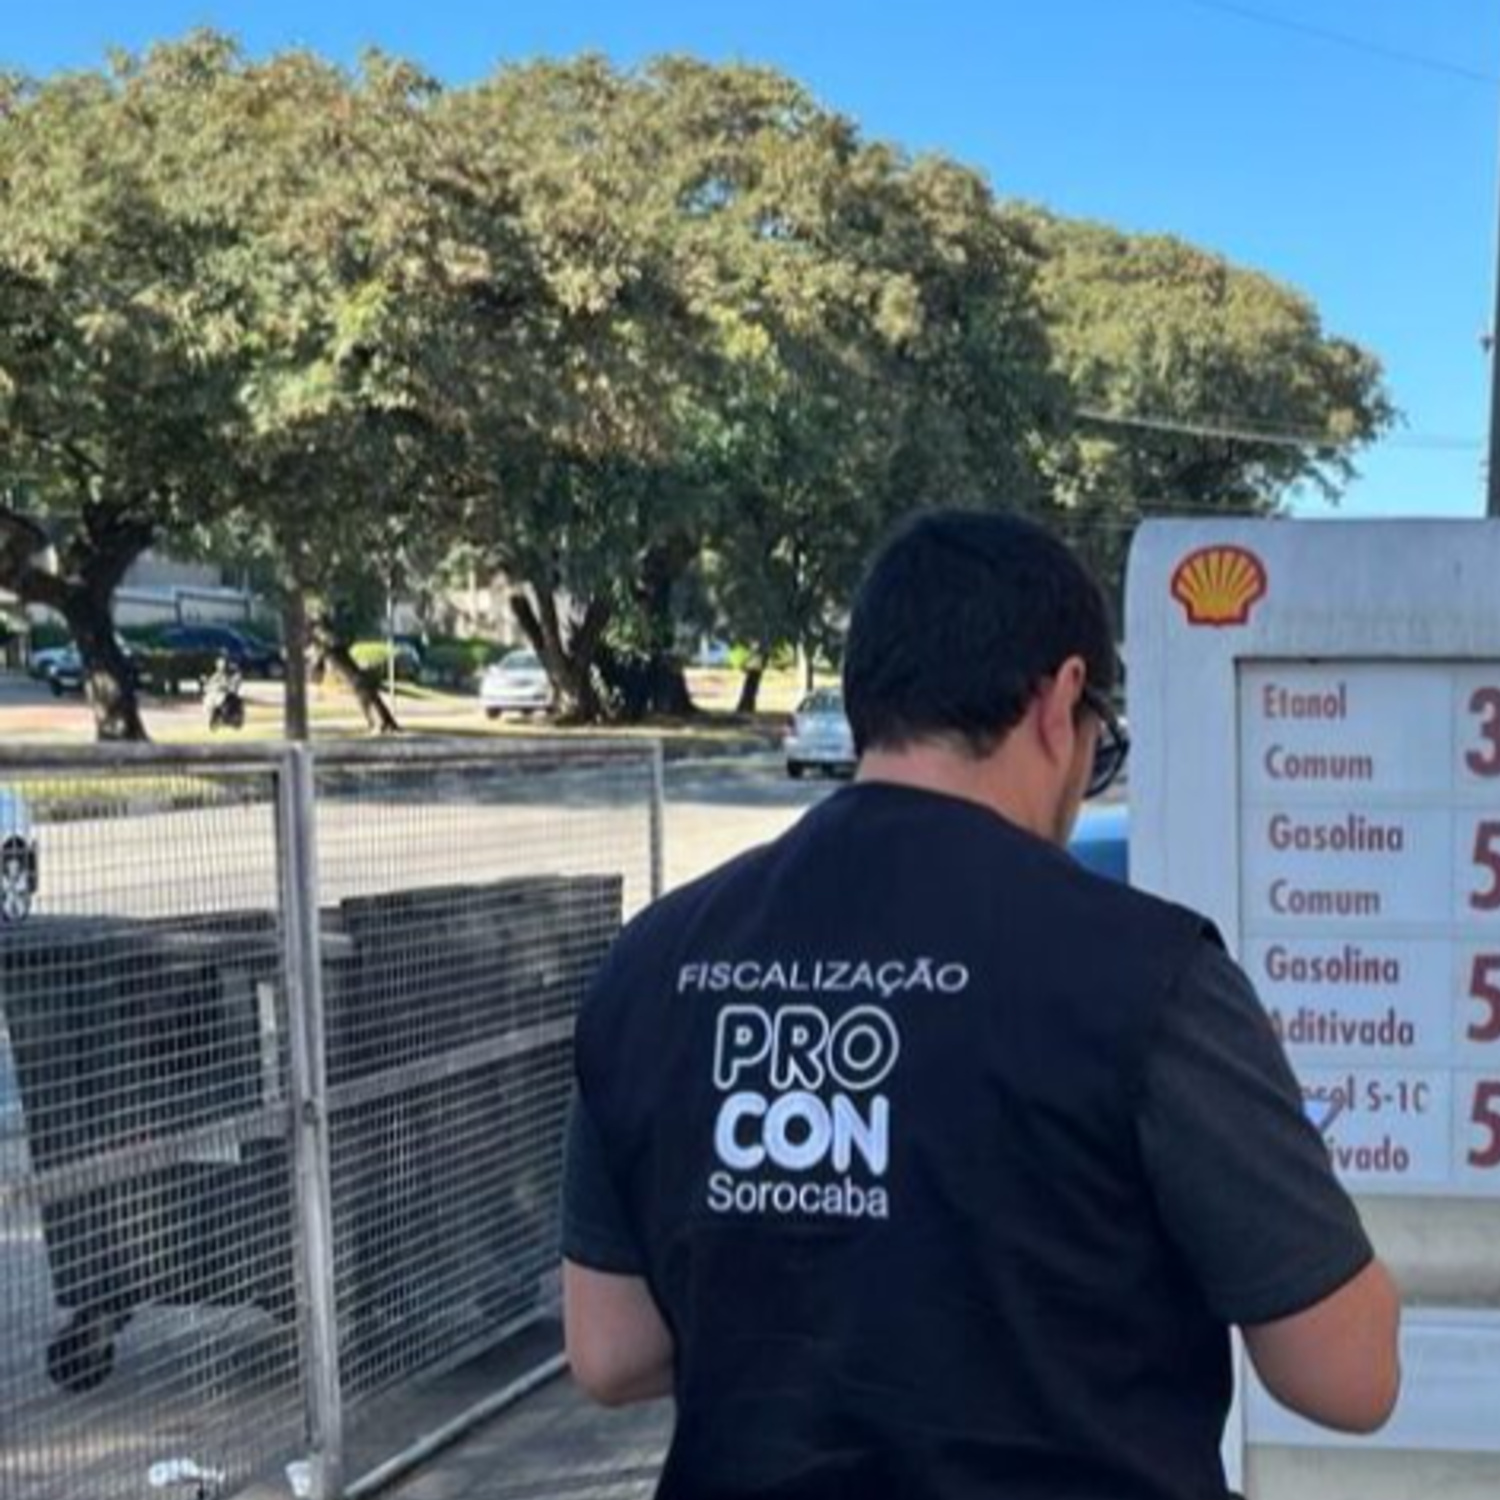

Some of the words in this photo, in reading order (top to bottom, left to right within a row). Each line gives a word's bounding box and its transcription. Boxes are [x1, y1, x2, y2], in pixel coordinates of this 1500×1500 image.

[1263, 680, 1347, 719] Etanol
[1264, 745, 1373, 779] Comum
[1268, 813, 1404, 851] Gasolina
[1269, 879, 1381, 915] Comum
[677, 957, 969, 997] FISCALIZAÇÃO
[1265, 945, 1399, 984] Gasolina
[713, 1005, 900, 1089] PRO
[715, 1090, 890, 1176] CON
[706, 1171, 889, 1218] Sorocaba
